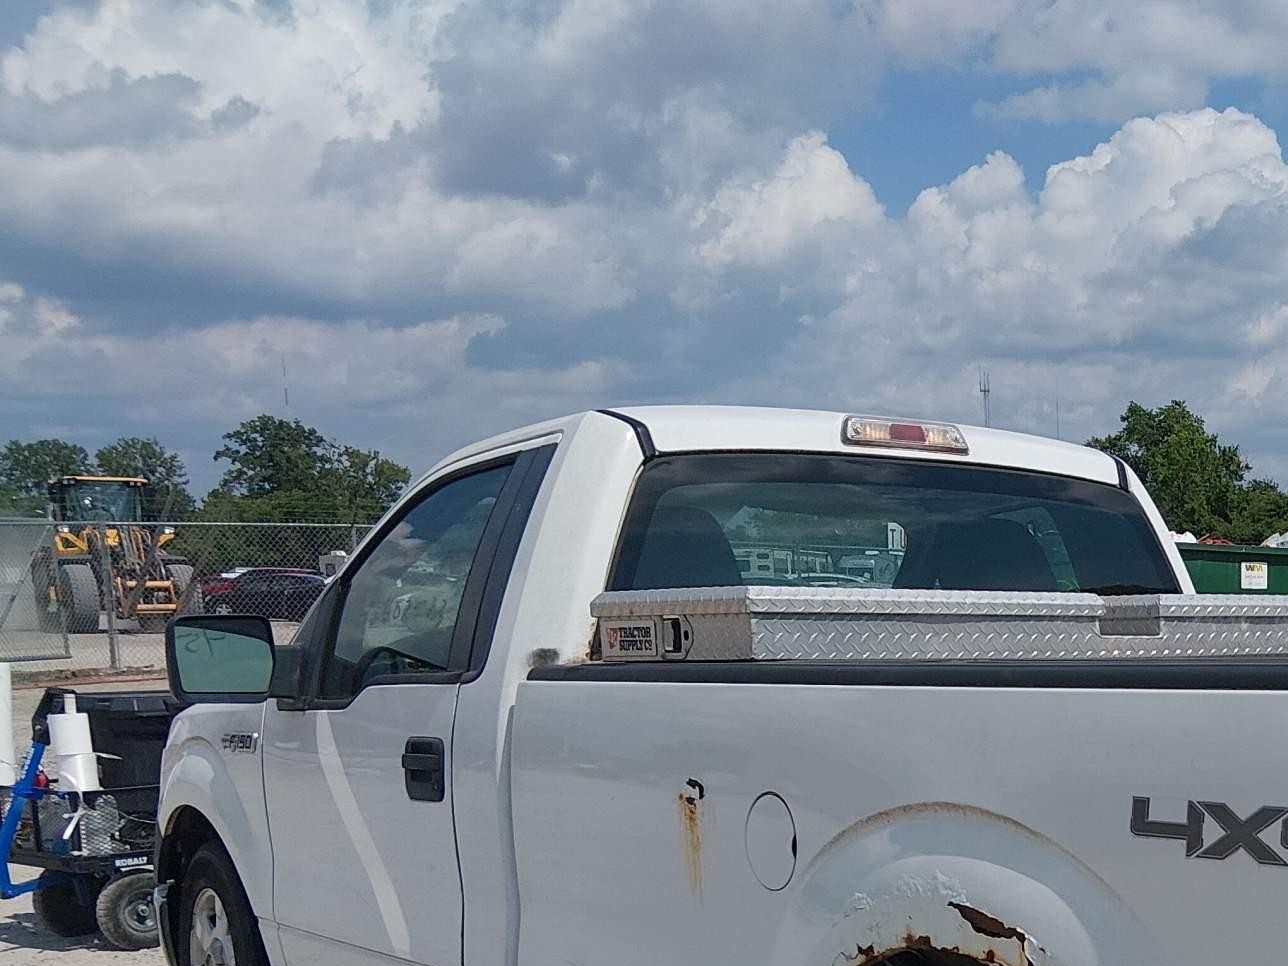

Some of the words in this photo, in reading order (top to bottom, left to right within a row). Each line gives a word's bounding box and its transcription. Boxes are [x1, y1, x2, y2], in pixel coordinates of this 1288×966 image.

[619, 626, 651, 638] TRACTOR
[619, 639, 643, 651] SUPPLY
[115, 856, 148, 867] KOBALT
